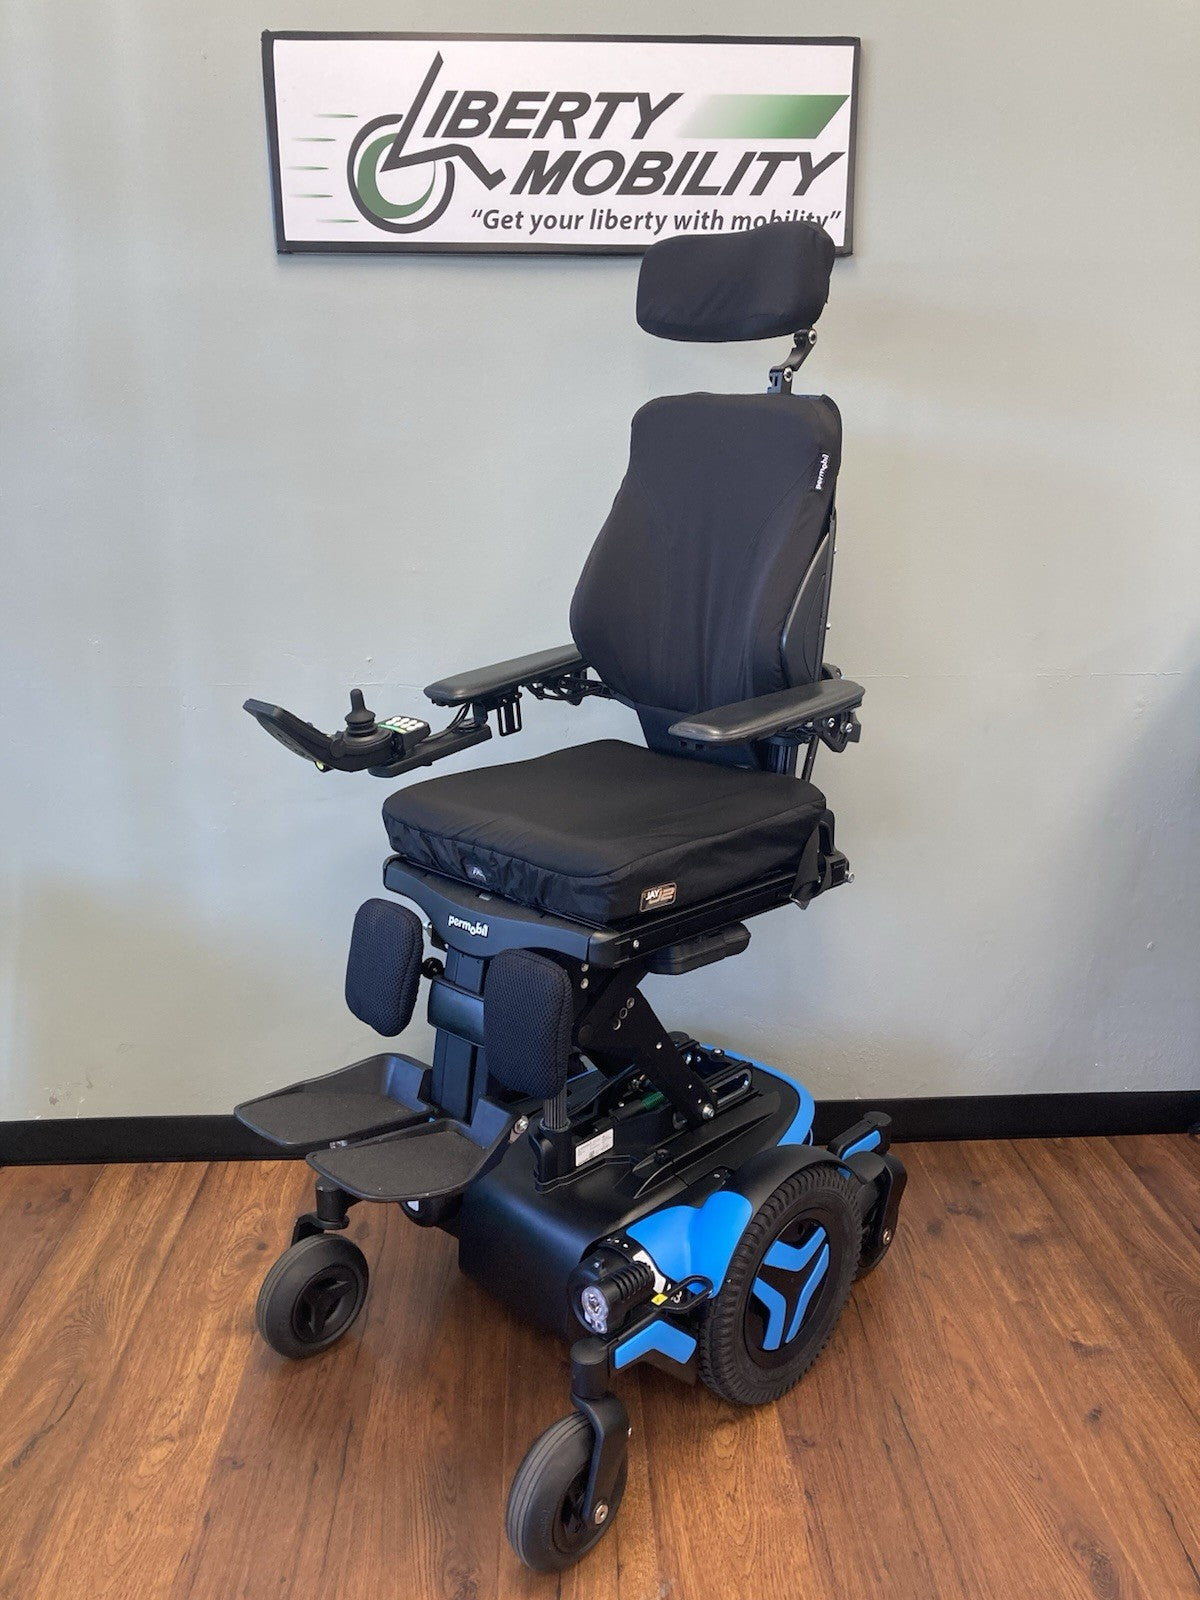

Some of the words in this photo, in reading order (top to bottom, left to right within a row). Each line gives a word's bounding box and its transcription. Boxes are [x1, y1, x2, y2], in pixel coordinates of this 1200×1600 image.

[380, 50, 685, 173] LIBERTY
[509, 150, 846, 196] MOBILITY
[529, 213, 584, 235] your
[589, 208, 668, 236] liberty
[674, 209, 724, 231] with
[815, 453, 830, 490] permobil
[645, 889, 660, 901] JAY
[448, 915, 489, 937] permobil
